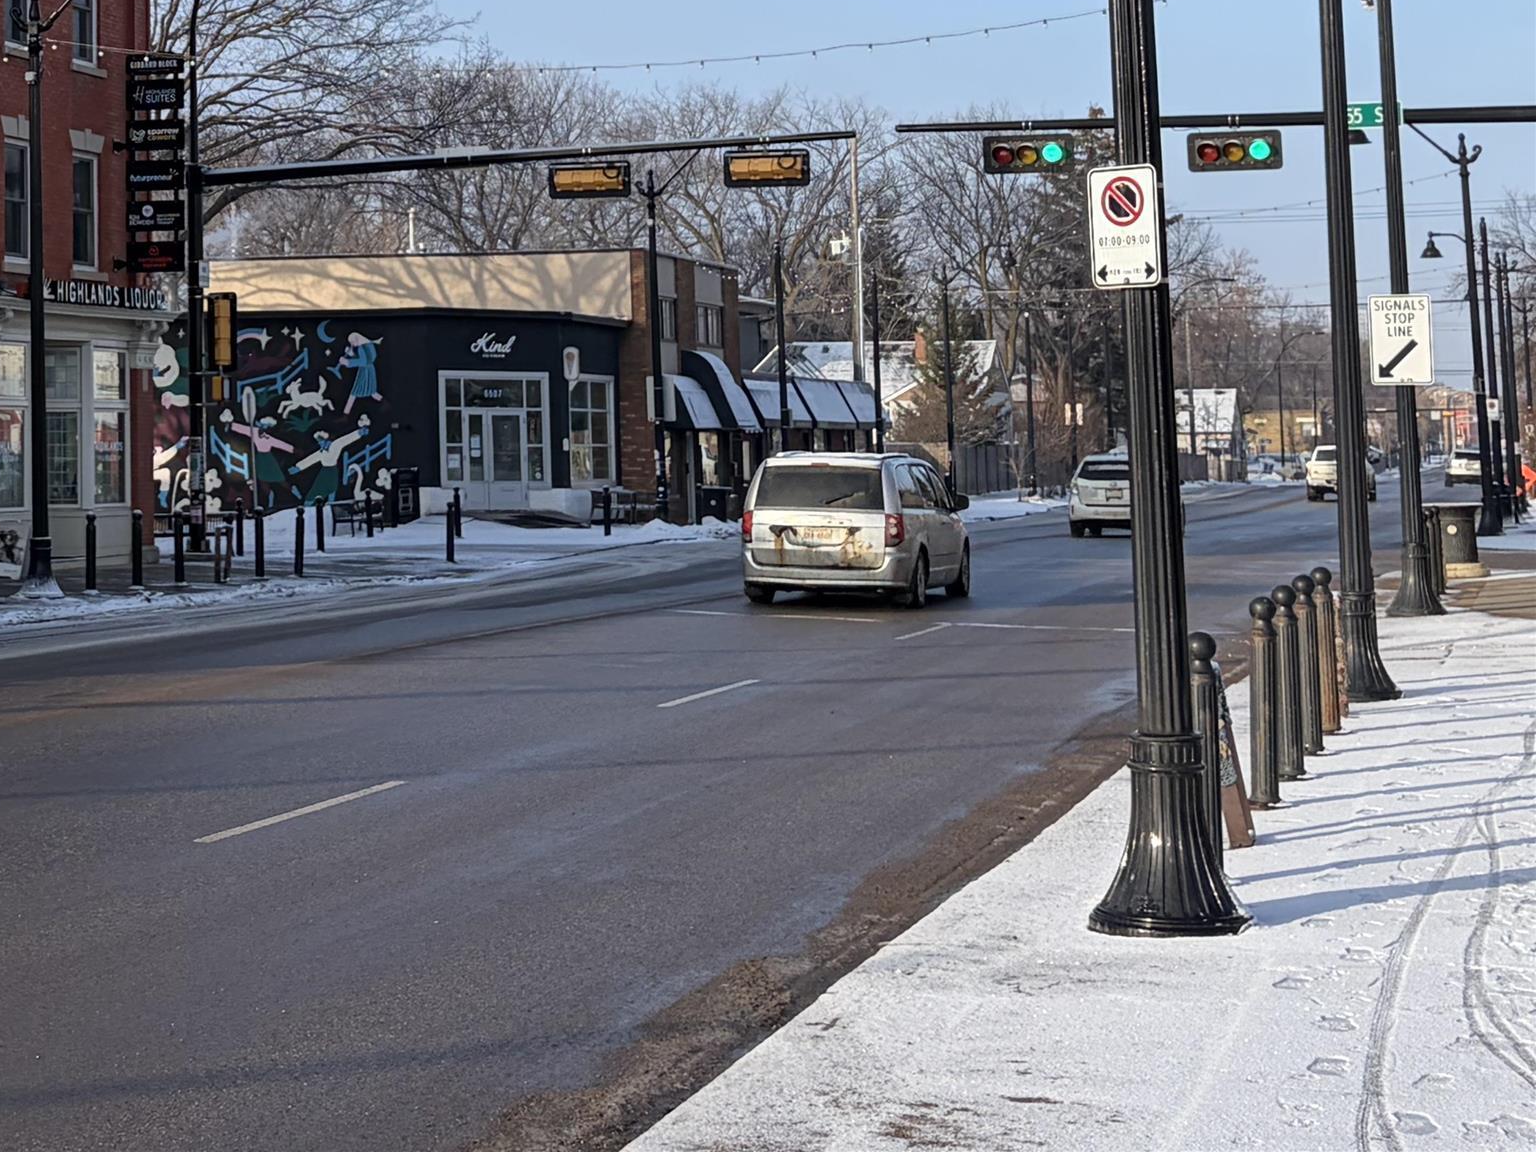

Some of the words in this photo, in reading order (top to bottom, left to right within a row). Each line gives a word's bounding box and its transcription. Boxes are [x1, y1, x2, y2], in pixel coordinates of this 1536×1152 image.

[145, 94, 176, 103] SUITES
[1374, 106, 1383, 123] S
[56, 280, 121, 306] HIGHLANDS
[1373, 299, 1426, 312] SIGNALS
[1384, 313, 1415, 325] STOP
[1387, 326, 1413, 337] LINE
[470, 332, 517, 353] Kind
